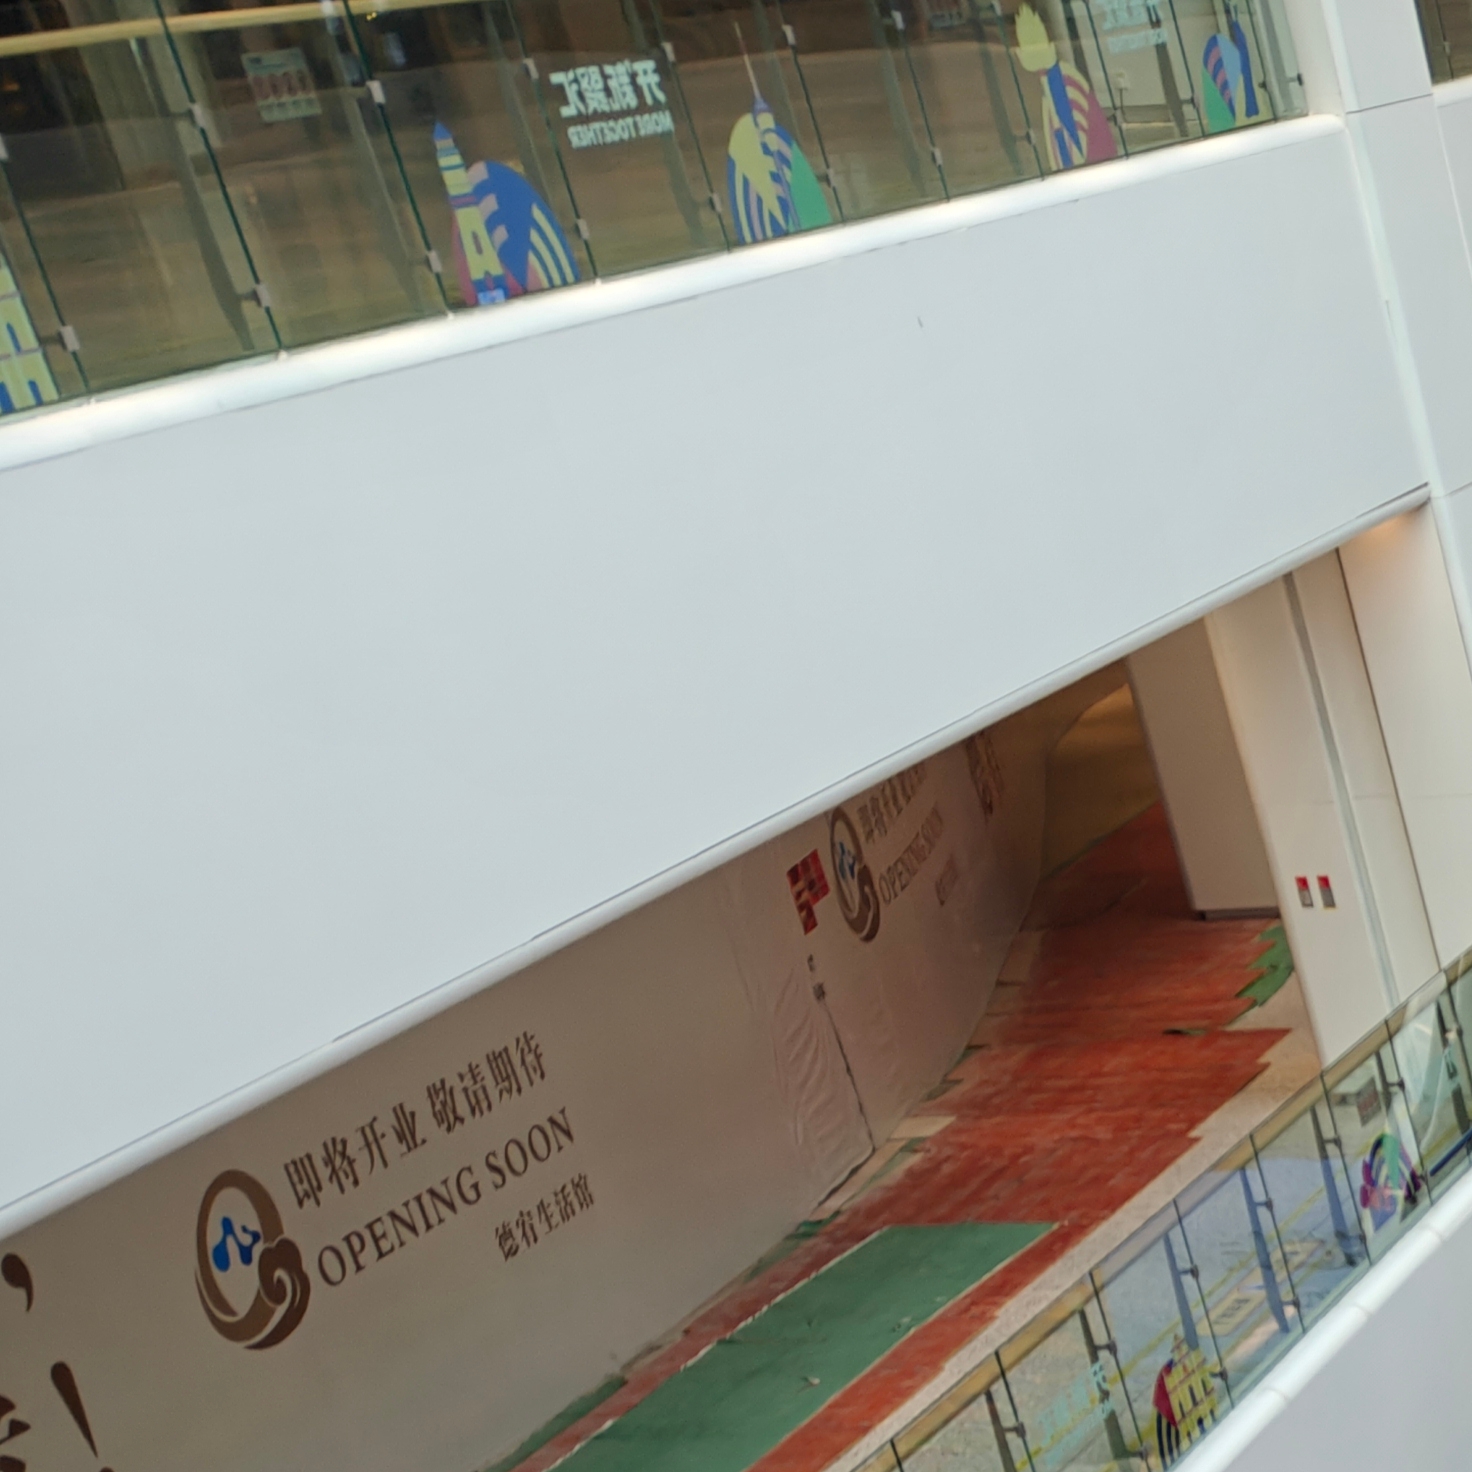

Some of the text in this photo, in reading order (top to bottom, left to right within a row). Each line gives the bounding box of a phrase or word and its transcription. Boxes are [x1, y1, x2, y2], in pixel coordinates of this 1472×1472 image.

[283, 1031, 546, 1210] 即将开业 敬请期待
[317, 1107, 575, 1287] OPENING SOON
